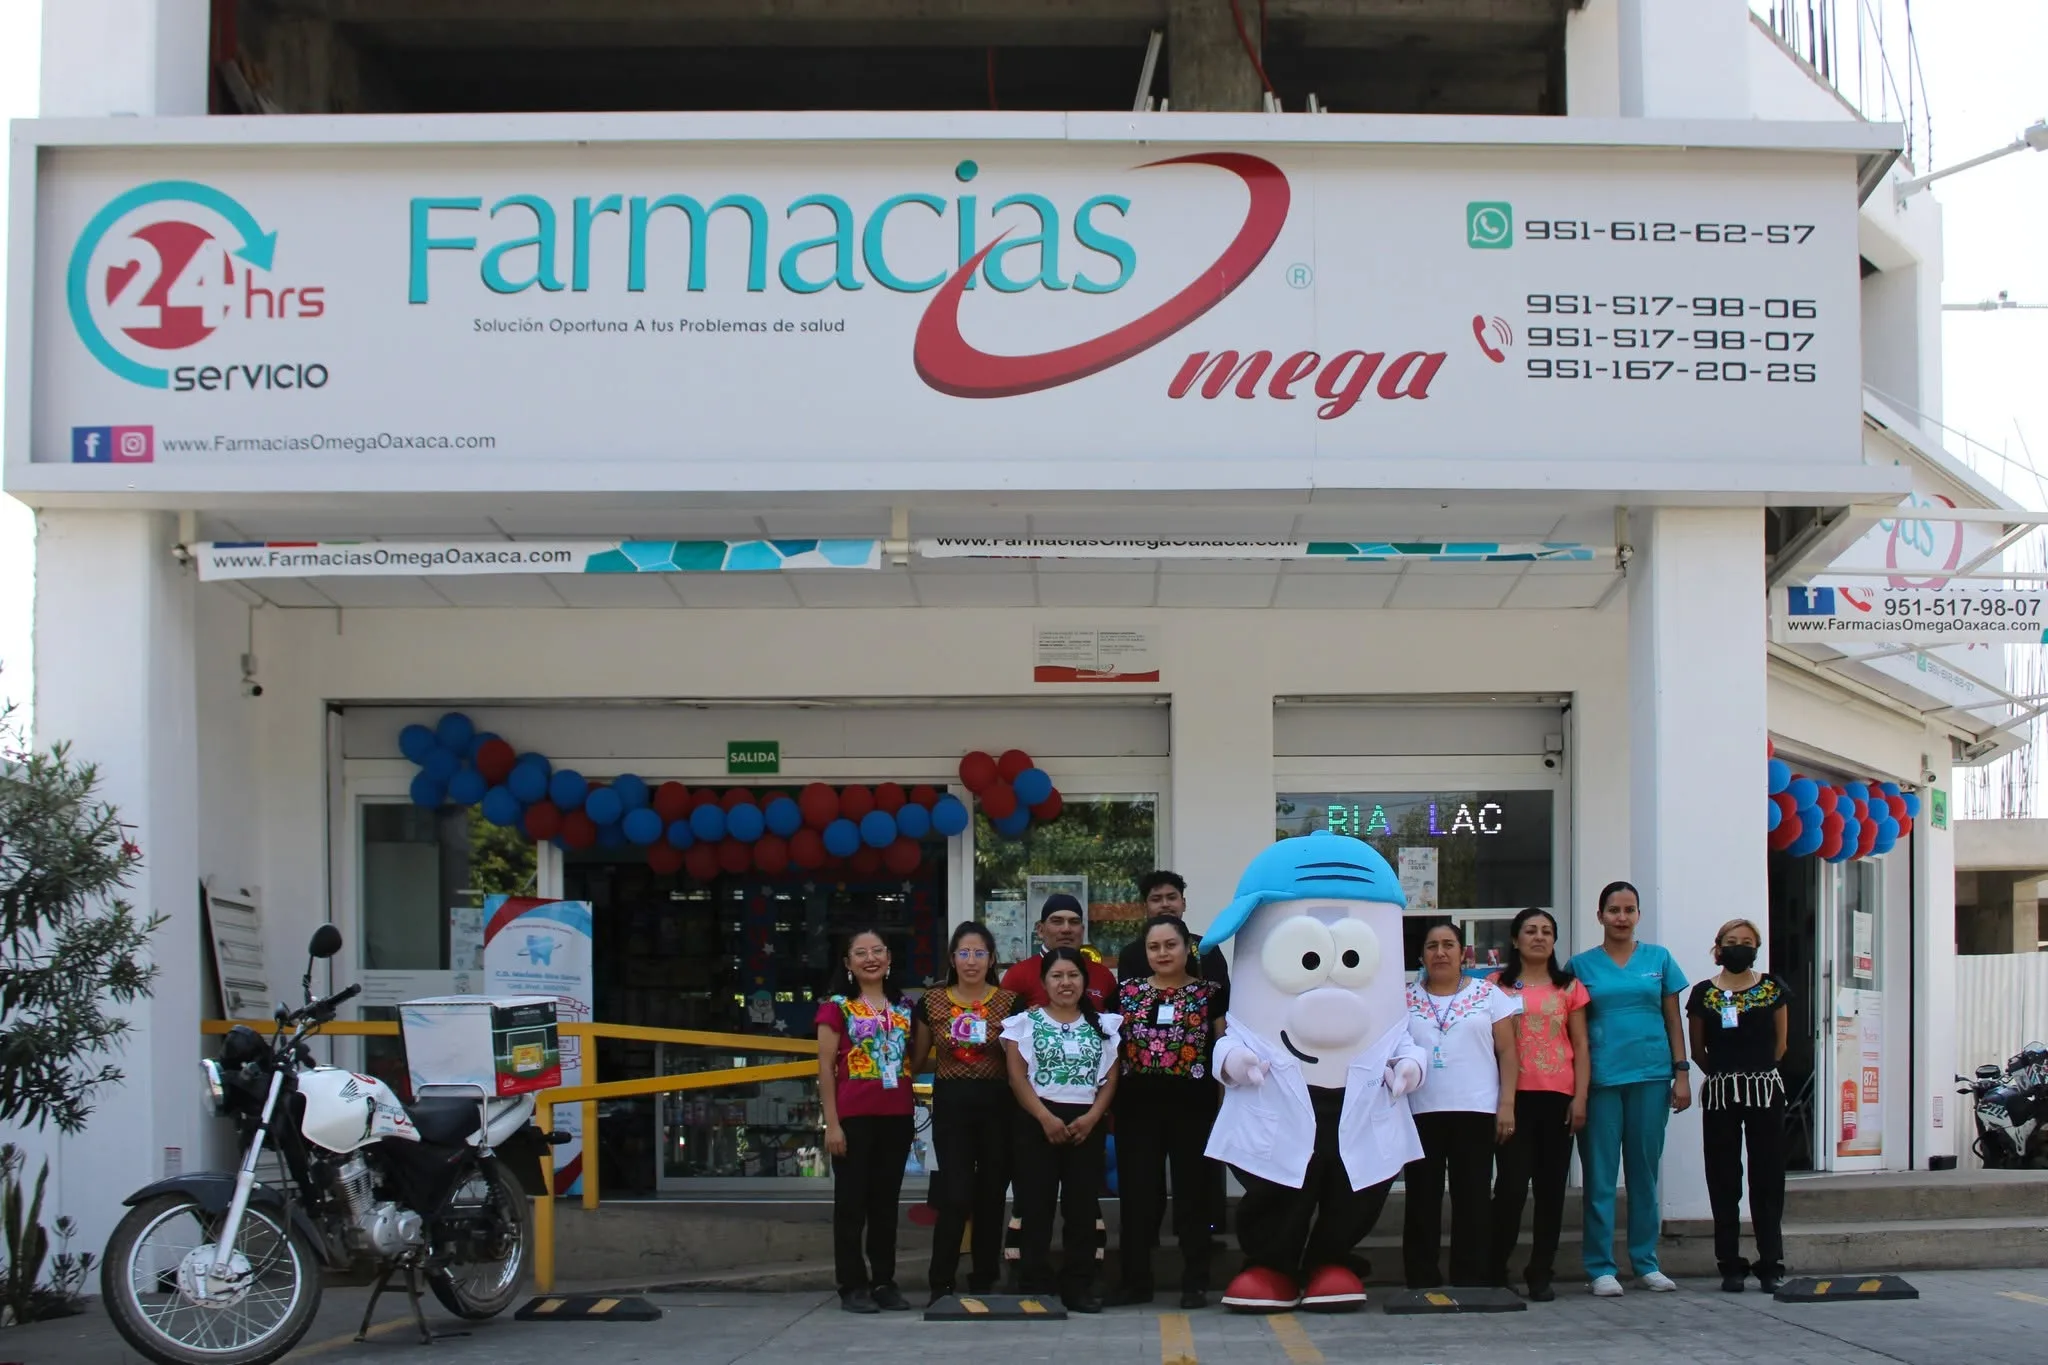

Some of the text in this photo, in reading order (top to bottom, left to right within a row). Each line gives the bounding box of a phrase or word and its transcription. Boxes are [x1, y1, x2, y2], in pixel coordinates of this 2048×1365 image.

[409, 160, 1137, 304] Farmacias
[1525, 220, 1816, 245] 951-612-62-57
[1526, 294, 1817, 320] 951-517-98-06
[473, 317, 845, 335] Solución Oportuna A tus Problemas de salud
[1527, 327, 1815, 352] 951-517-98-07
[173, 363, 329, 392] servicio
[1526, 358, 1817, 383] 951-167-20-25
[162, 432, 496, 454] www.FarmaciasOmegaOaxaca.com
[212, 547, 572, 570] www.FarmaciasOmegaOaxaca.com
[1884, 598, 2041, 617] 951-517-98-07
[1787, 617, 2041, 634] www.FarmaciasOmegaOaxaca.com
[730, 752, 777, 763] SALIDA
[1328, 803, 1502, 836] RIA LAC
